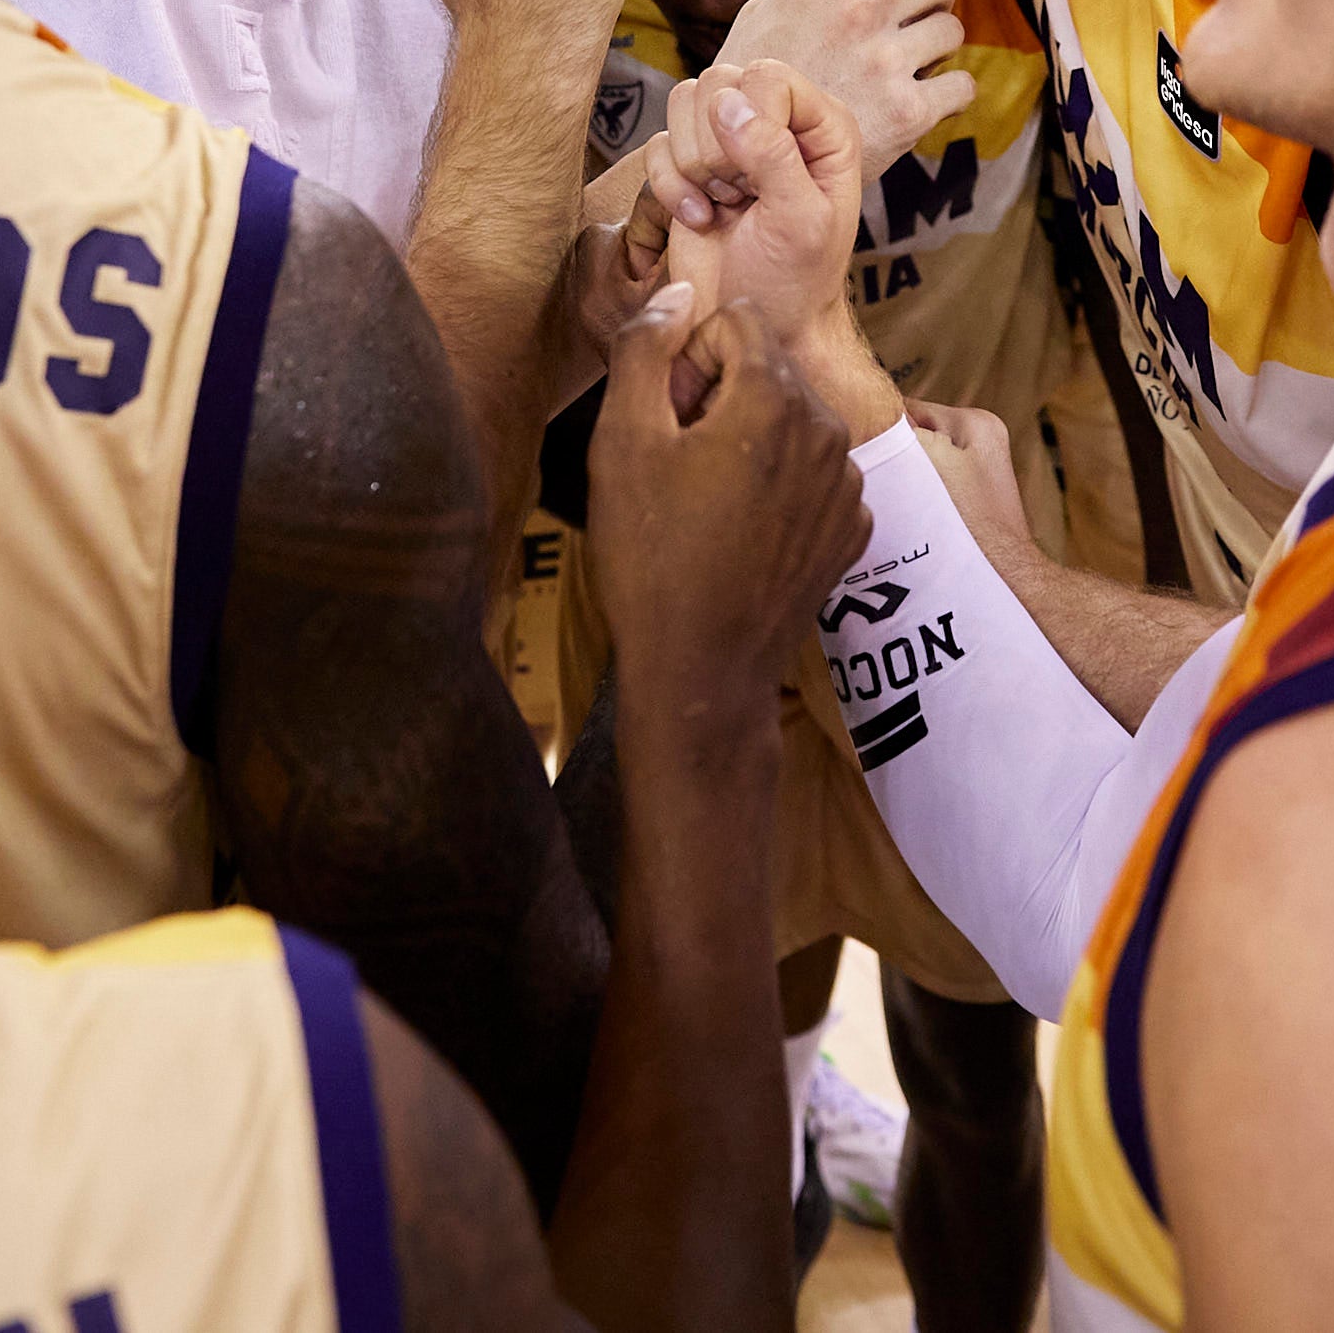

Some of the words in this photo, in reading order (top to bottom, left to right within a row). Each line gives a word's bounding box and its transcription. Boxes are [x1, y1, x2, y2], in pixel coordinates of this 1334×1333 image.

[1160, 56, 1181, 97] liga
[1160, 84, 1214, 149] endesa
[848, 254, 921, 304] IA
